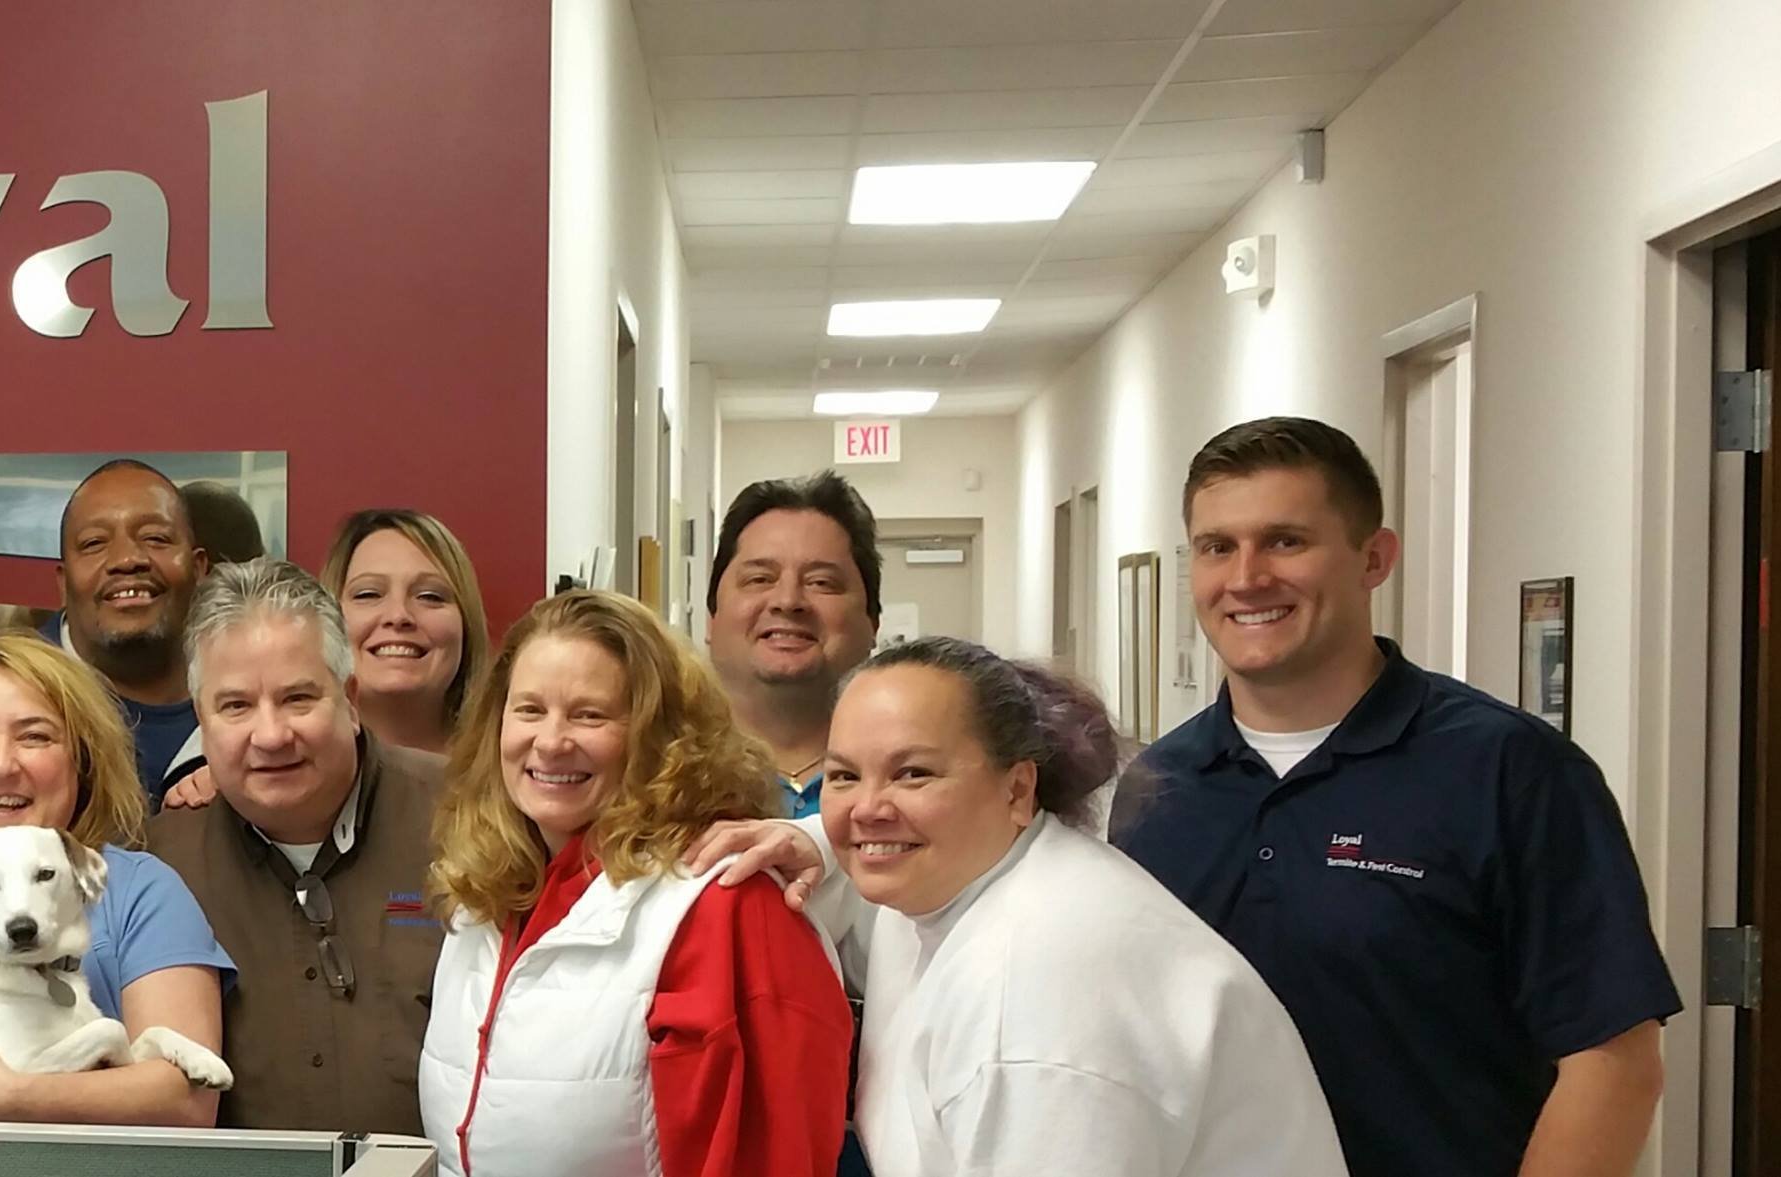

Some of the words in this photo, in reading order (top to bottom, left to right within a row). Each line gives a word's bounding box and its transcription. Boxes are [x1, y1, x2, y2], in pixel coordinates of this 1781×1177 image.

[847, 426, 890, 456] EXIT
[1331, 833, 1362, 847] Loyal
[1386, 864, 1424, 879] Control
